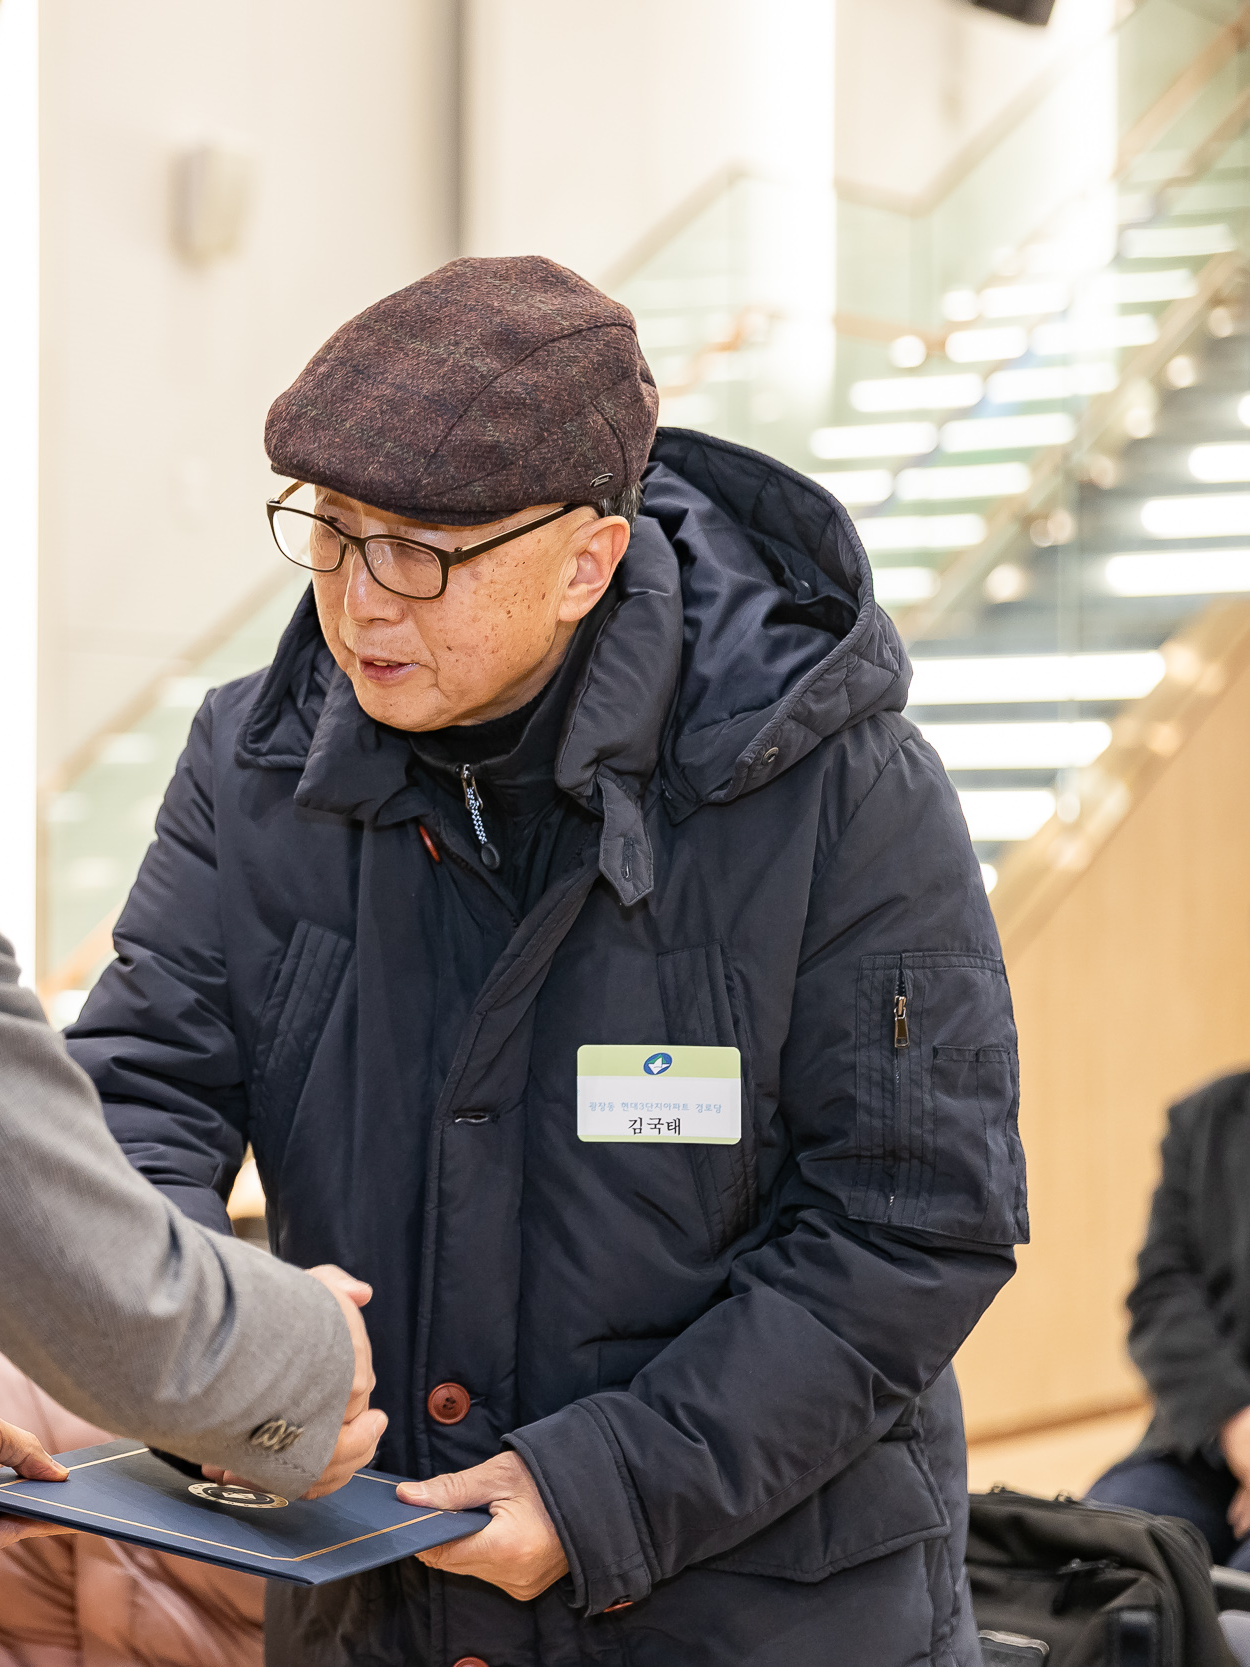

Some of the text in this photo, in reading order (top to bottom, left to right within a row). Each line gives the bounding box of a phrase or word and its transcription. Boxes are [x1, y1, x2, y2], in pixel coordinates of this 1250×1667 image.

[588, 1101, 722, 1114] 광장동 현대3단지아파트 경로당
[628, 1117, 681, 1136] 김국태
